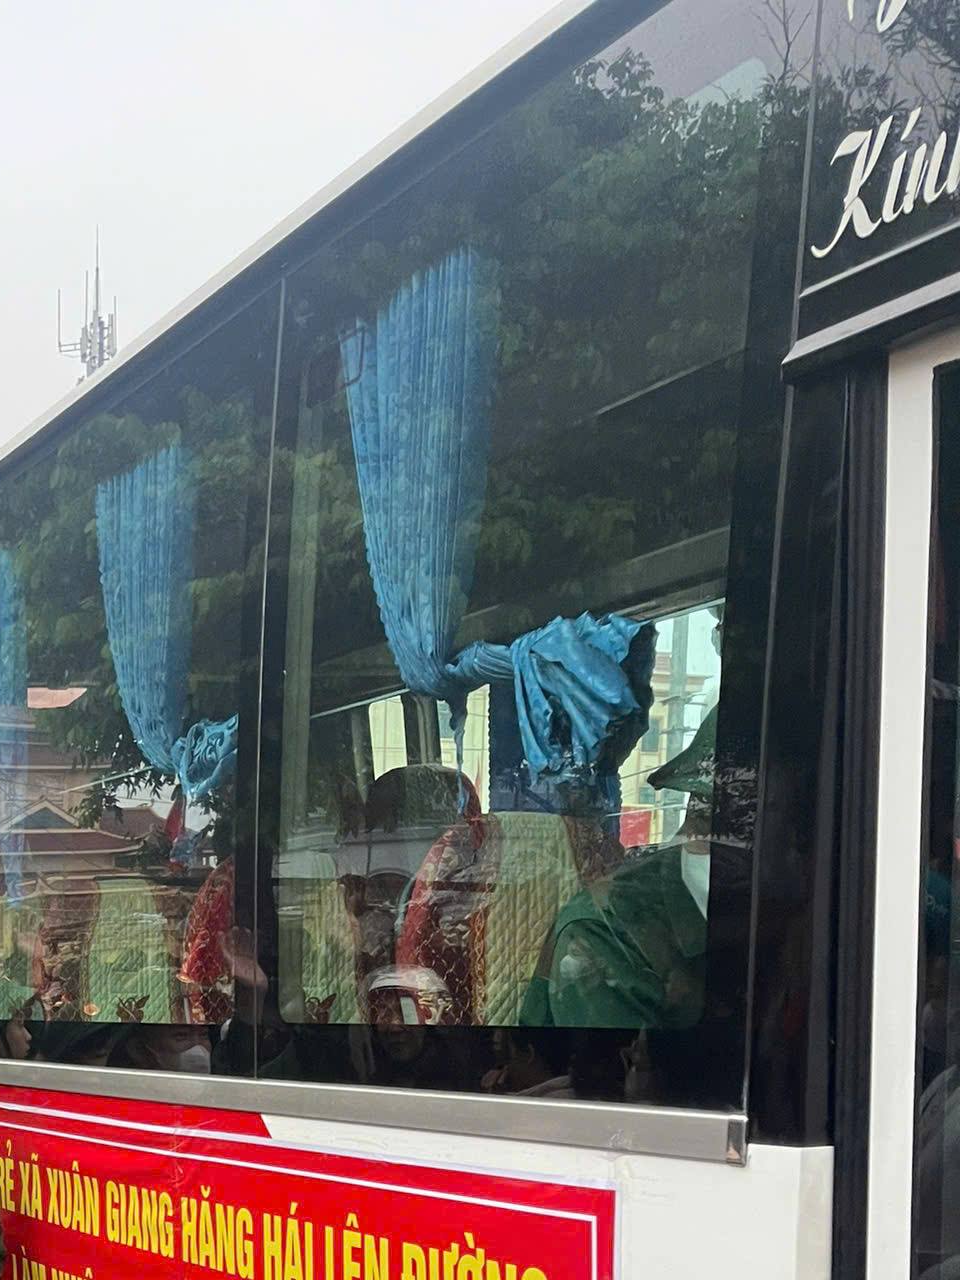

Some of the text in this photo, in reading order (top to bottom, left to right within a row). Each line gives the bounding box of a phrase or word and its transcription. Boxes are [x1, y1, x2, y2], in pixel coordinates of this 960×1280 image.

[19, 1152, 44, 1221] XÃ
[46, 1160, 100, 1237] XUÂN
[105, 1180, 175, 1258] GIANG
[180, 1185, 255, 1280] HĂNG
